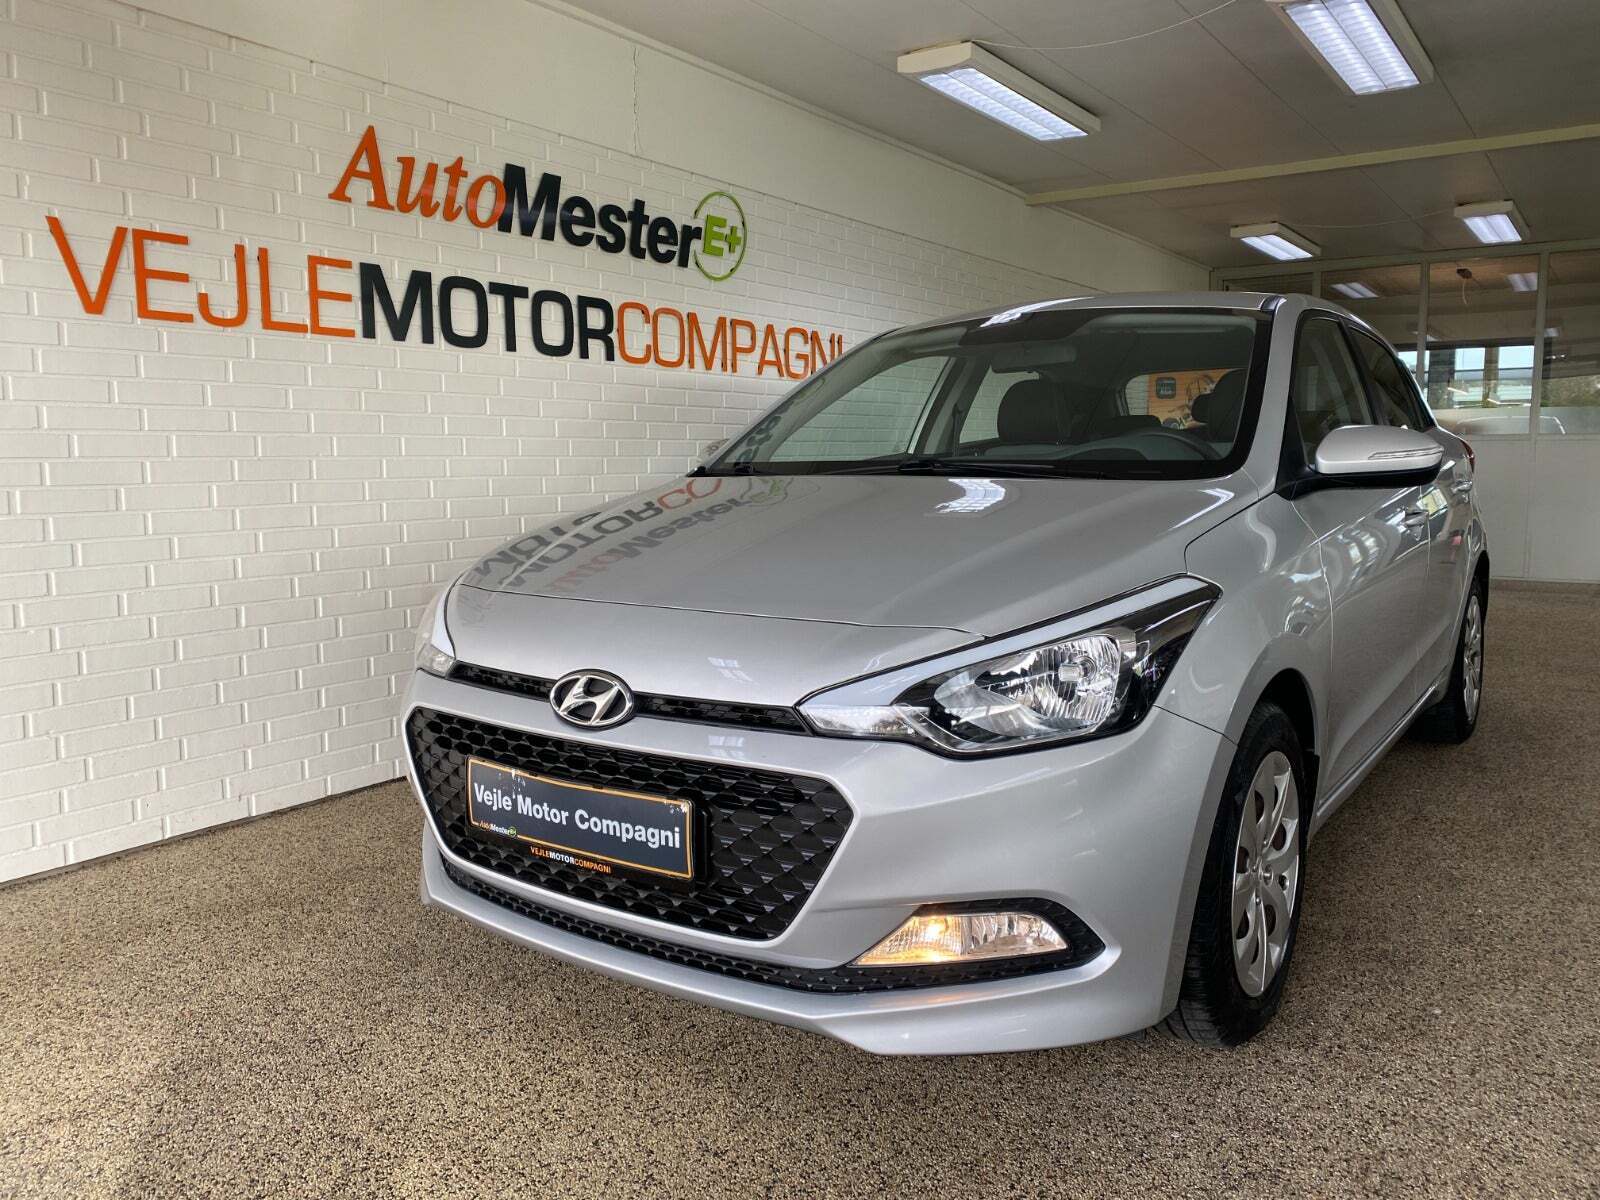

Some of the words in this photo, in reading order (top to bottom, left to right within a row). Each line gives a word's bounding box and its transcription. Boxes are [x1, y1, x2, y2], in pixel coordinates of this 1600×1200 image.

[328, 125, 702, 268] AutoMester
[473, 782, 512, 811] Vejle
[517, 793, 569, 826] Motor
[574, 808, 681, 849] Compagni
[530, 846, 611, 873] VEJLEMOTORCOMPAGNI
